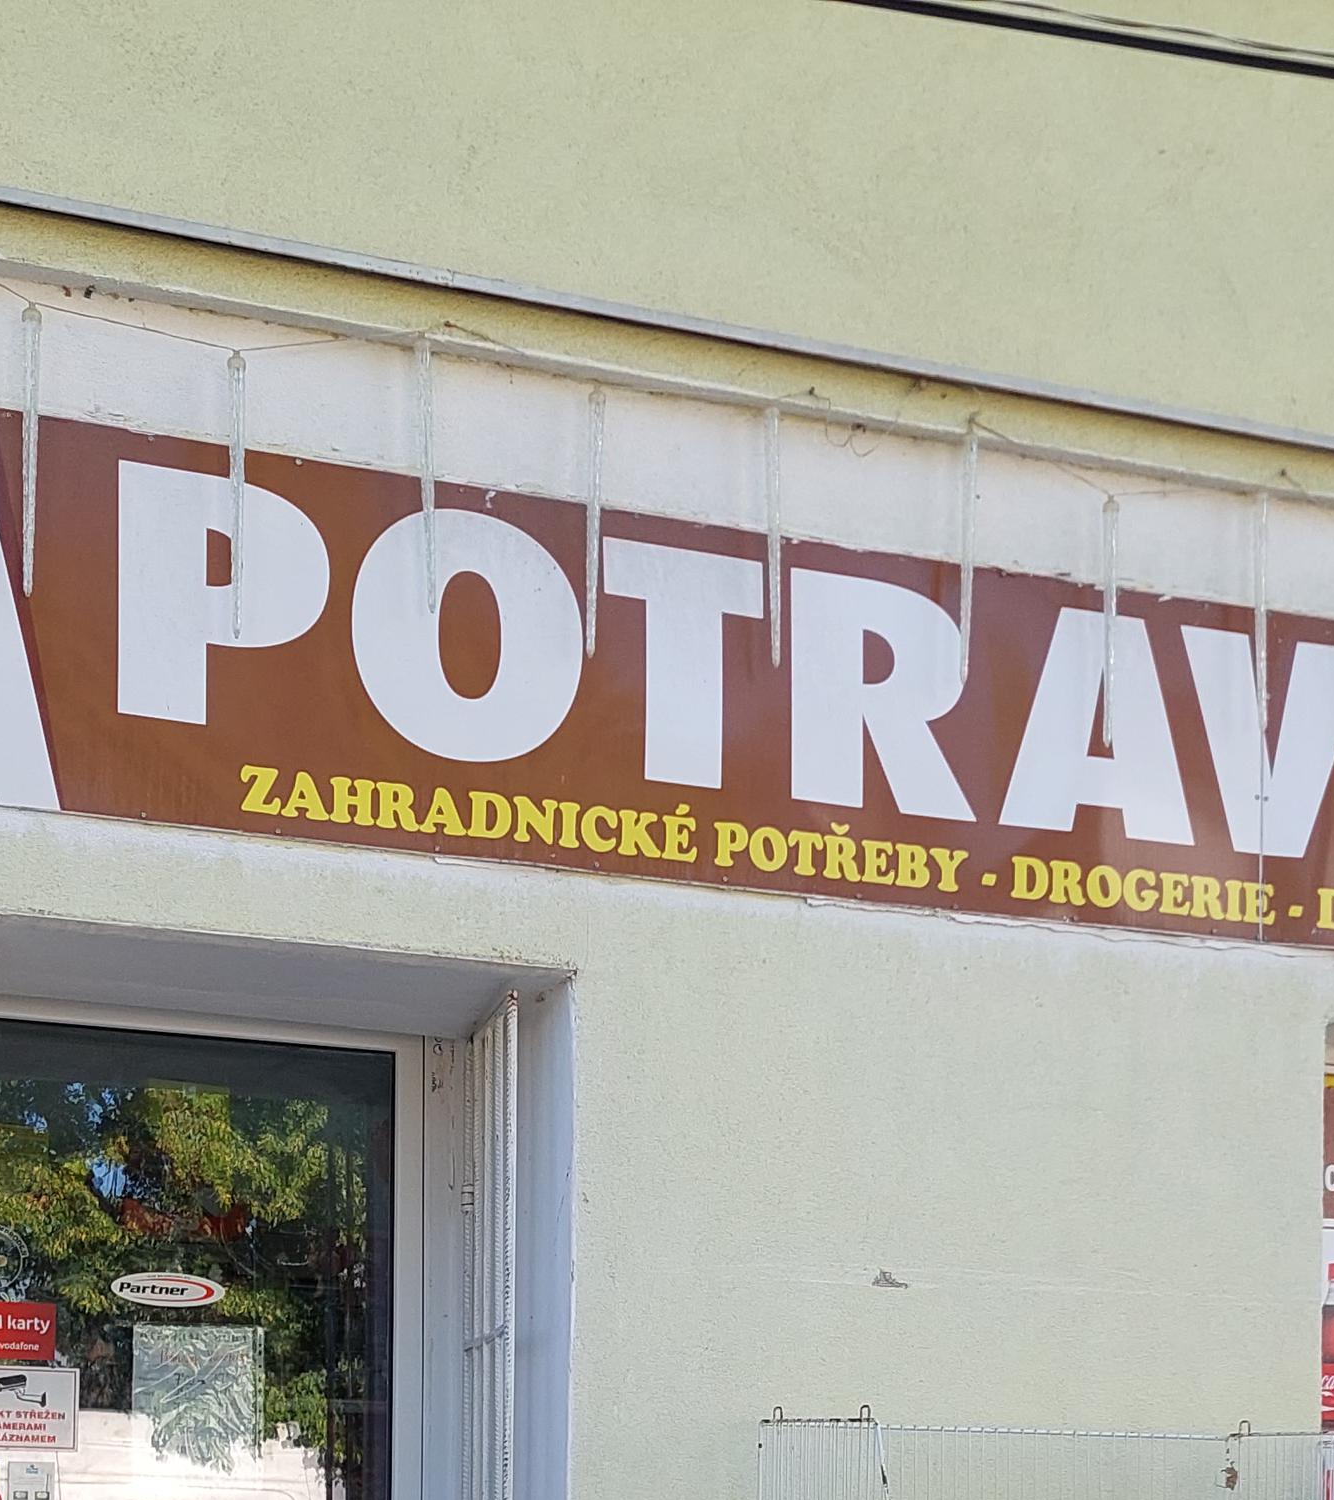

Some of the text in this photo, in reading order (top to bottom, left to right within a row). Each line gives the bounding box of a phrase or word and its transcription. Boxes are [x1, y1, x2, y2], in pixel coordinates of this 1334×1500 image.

[239, 764, 698, 865] ZAHRADNICKÉ
[715, 822, 973, 894] POTŘEBY
[1012, 854, 1275, 927] DROGERIE
[118, 1282, 189, 1296] Partner
[7, 1315, 50, 1334] karty
[0, 1342, 40, 1351] vodafone
[15, 1408, 66, 1420] STŘEŽEN
